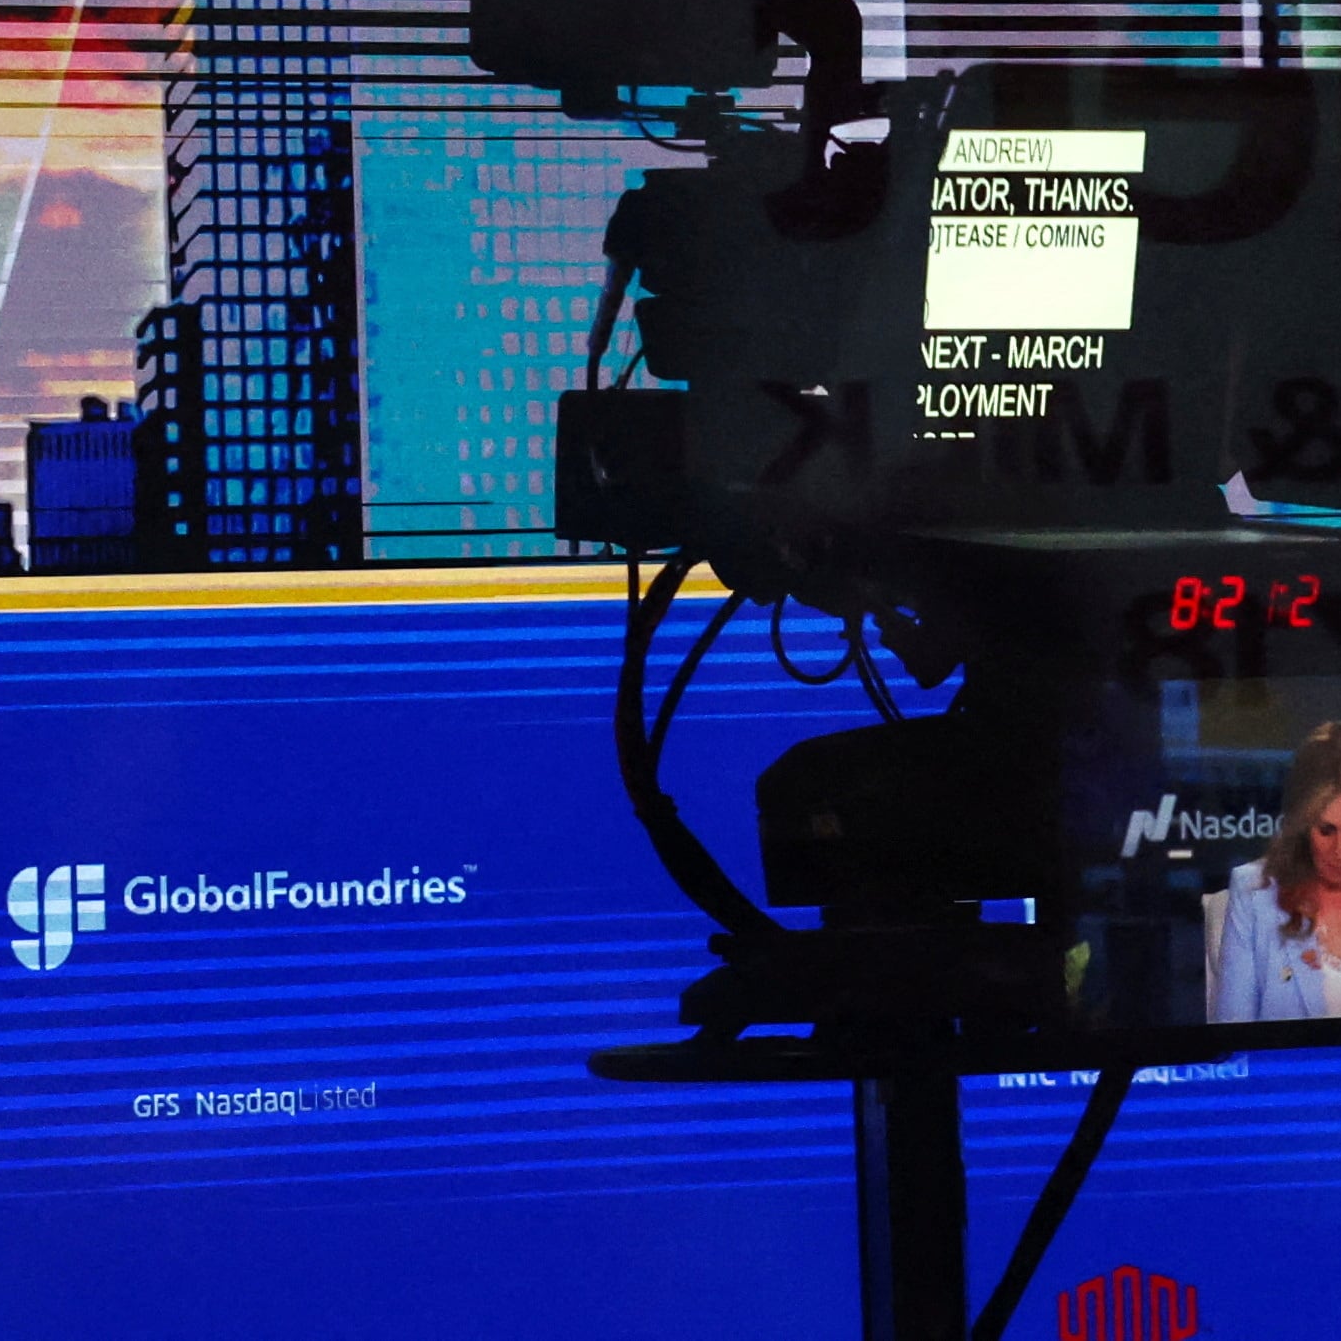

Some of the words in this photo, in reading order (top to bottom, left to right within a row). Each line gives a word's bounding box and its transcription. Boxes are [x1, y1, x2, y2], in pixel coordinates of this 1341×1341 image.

[953, 136, 1054, 172] ANDREW)
[1024, 176, 1135, 212] THANKS.
[1025, 222, 1106, 249] COMING
[1007, 334, 1104, 370] MARCH
[122, 865, 467, 915] GlobalFoundries
[133, 1092, 181, 1118] GFS
